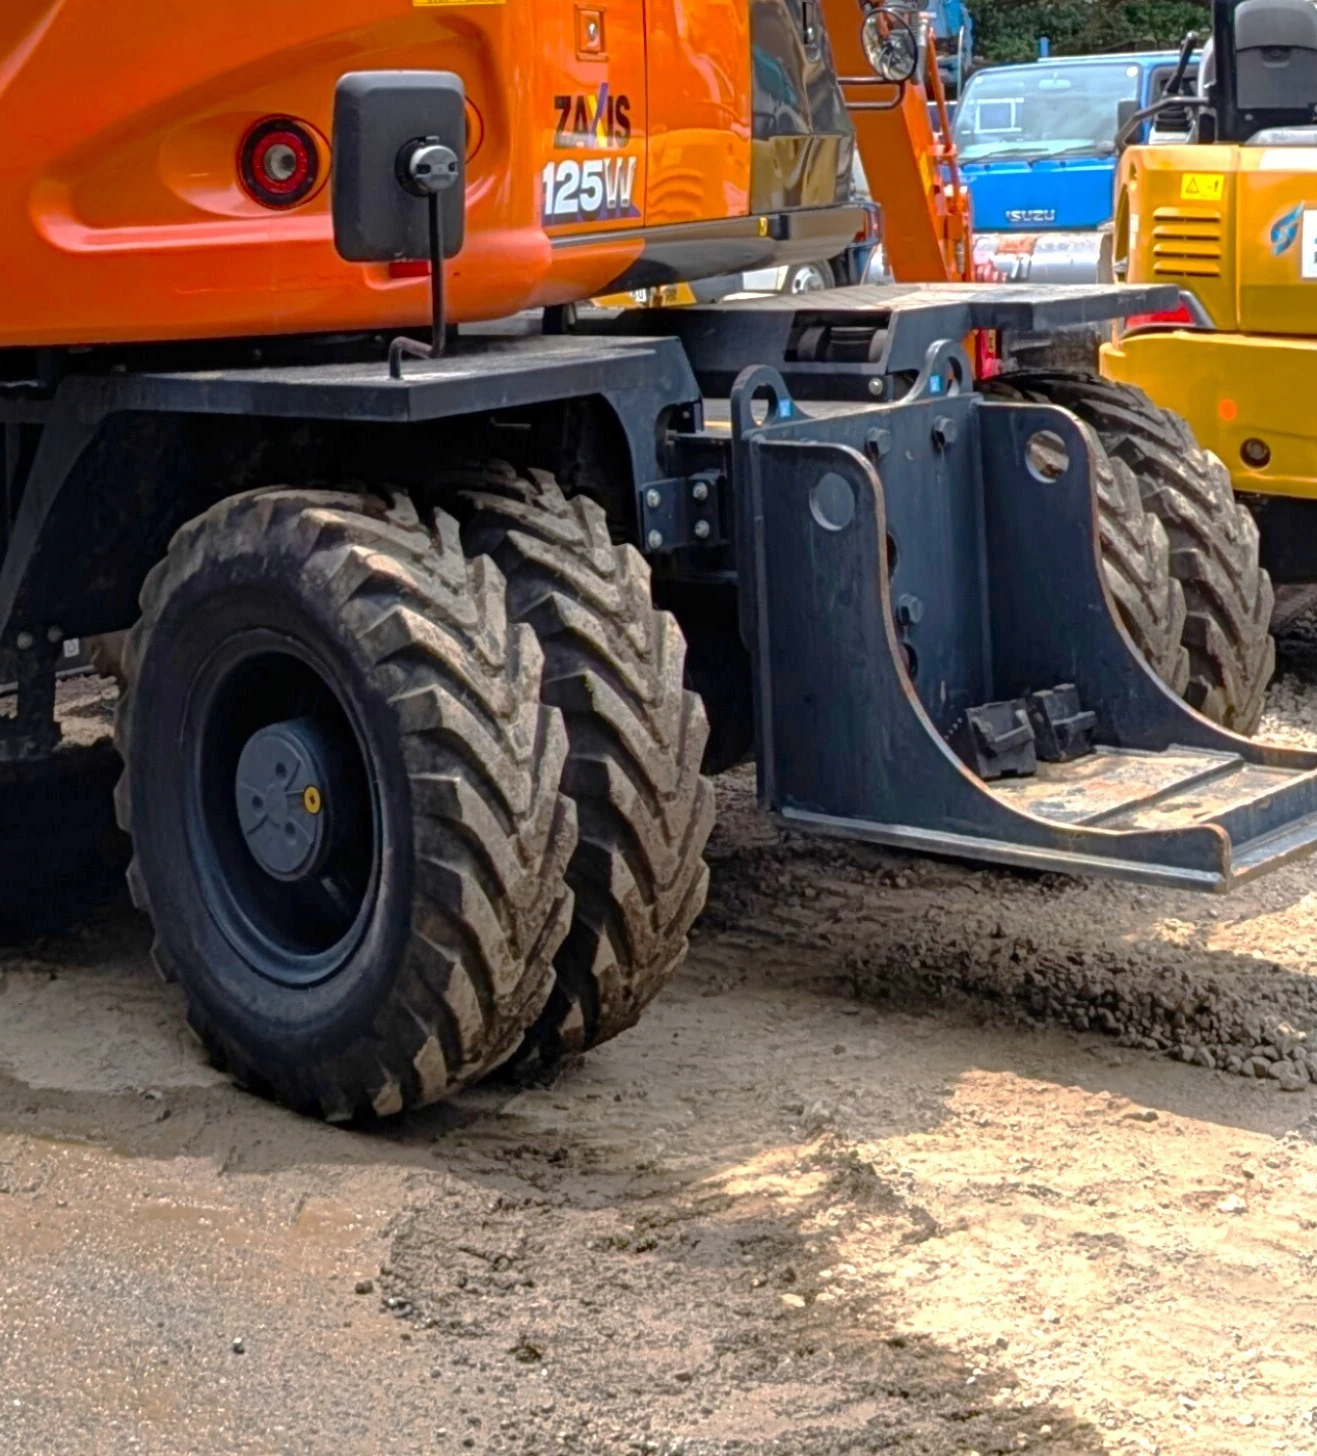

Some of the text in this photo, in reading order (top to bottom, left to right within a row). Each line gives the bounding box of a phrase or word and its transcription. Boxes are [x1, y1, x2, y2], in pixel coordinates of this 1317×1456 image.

[553, 82, 631, 150] ZAXIS
[542, 155, 637, 215] 125W
[1005, 209, 1056, 222] ISUZU
